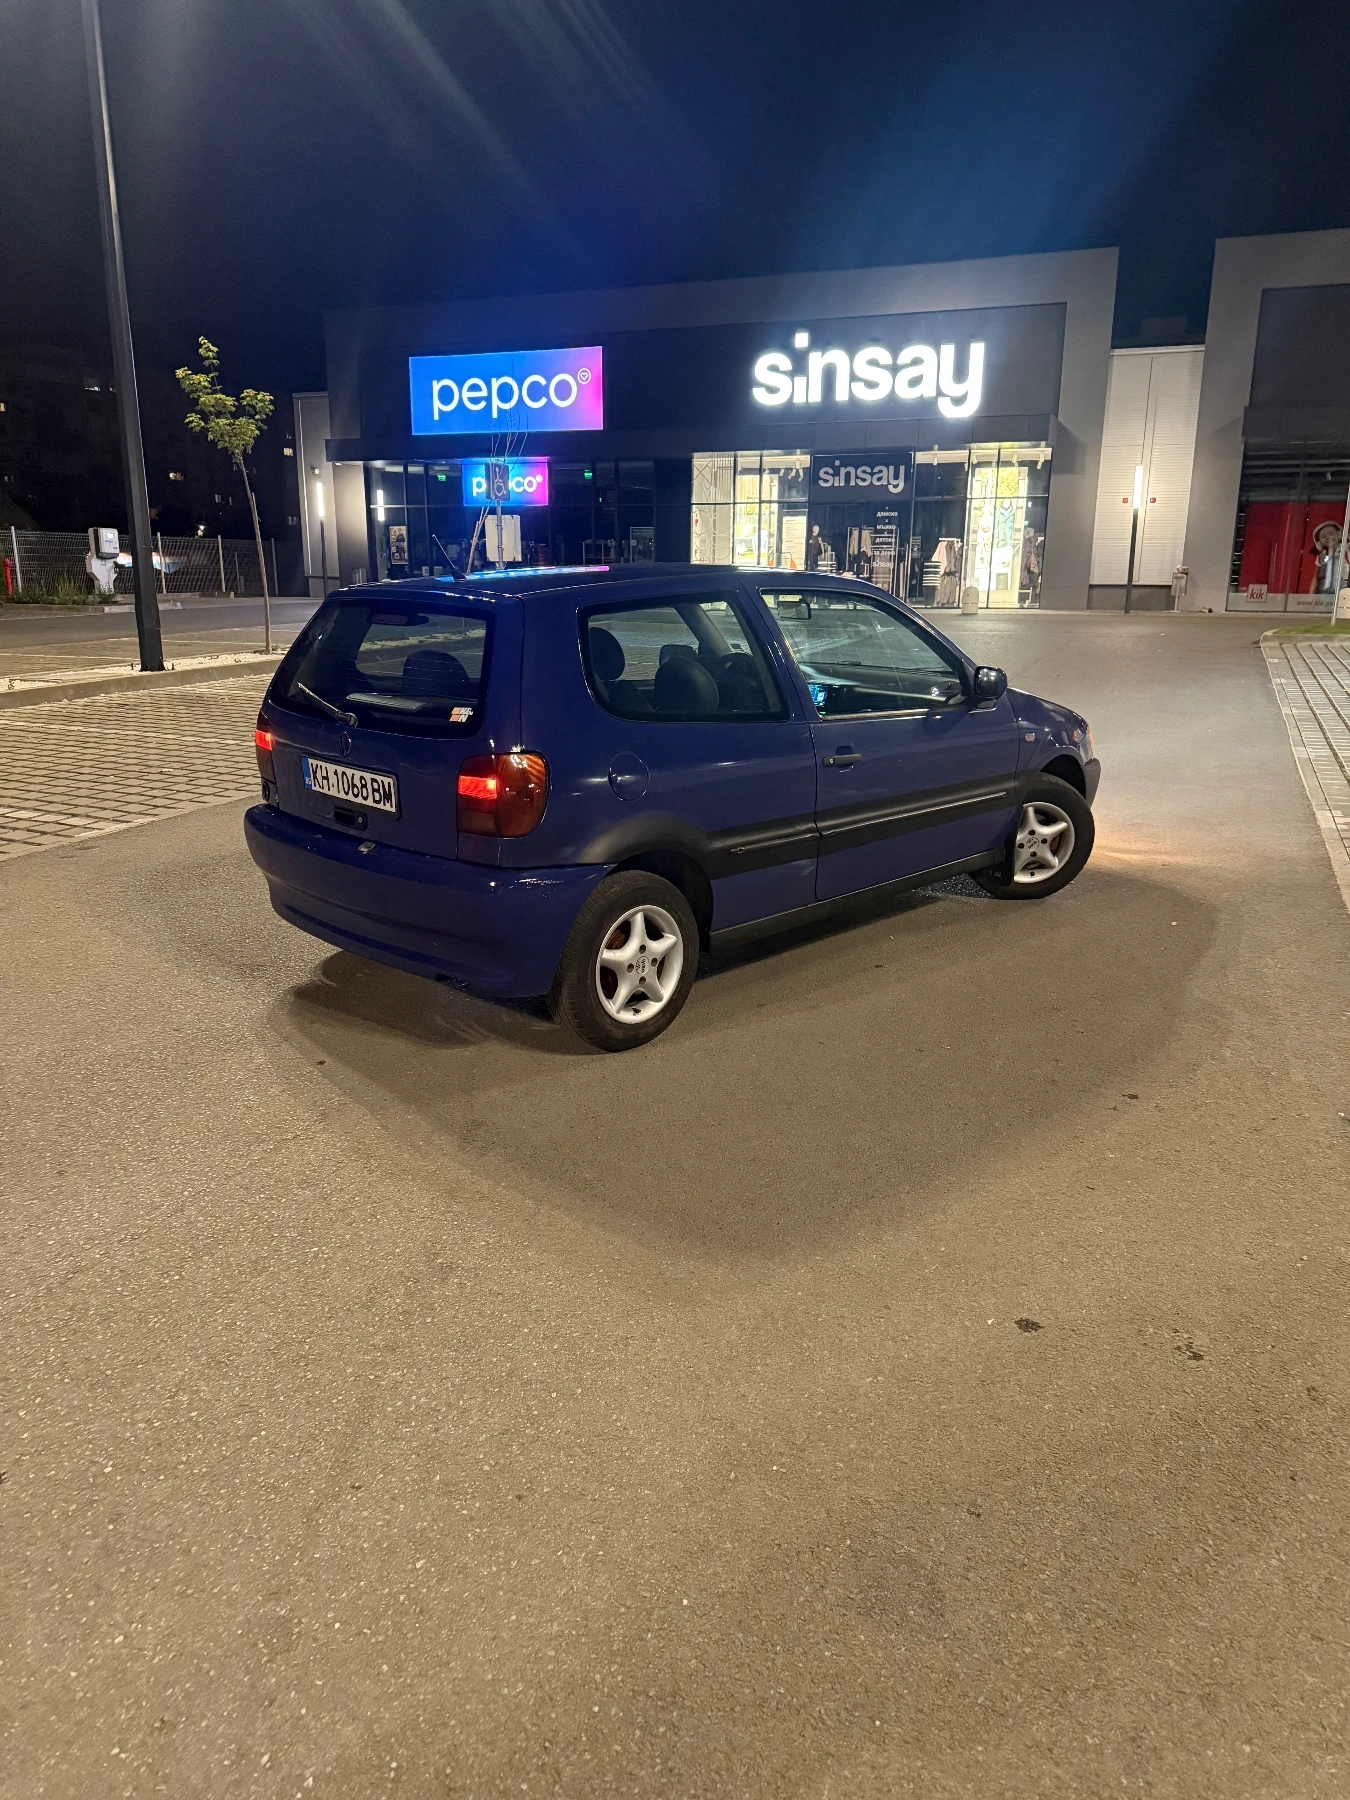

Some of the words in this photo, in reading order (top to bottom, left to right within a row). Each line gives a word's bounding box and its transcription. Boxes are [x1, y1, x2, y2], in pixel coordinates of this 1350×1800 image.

[752, 331, 986, 418] sinsay
[431, 372, 578, 421] pepco
[472, 476, 537, 497] pco
[818, 460, 905, 494] sinsay
[1249, 588, 1264, 600] kik
